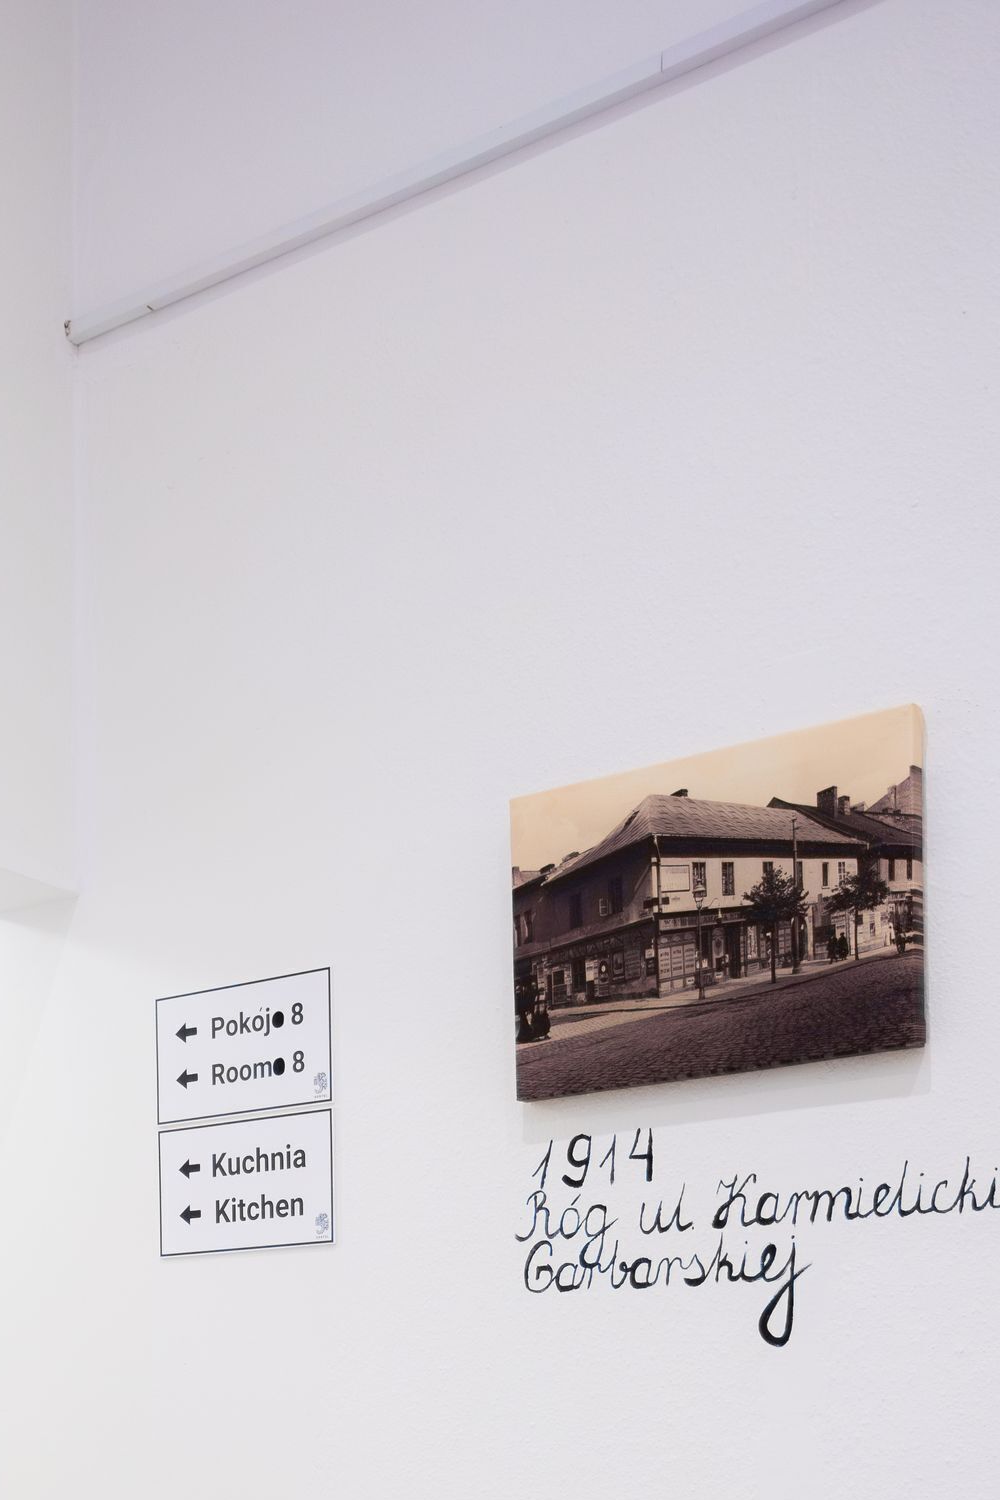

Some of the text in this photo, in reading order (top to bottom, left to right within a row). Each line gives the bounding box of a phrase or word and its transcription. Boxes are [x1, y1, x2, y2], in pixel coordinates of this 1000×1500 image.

[291, 1002, 304, 1025] 8
[211, 1050, 305, 1086] Room 8
[211, 1144, 307, 1178] Kuchnia
[532, 1127, 654, 1189] 1914
[215, 1194, 305, 1224] Kitchen
[515, 1189, 617, 1268] Róg
[523, 1233, 812, 1348] Garbarskiej
